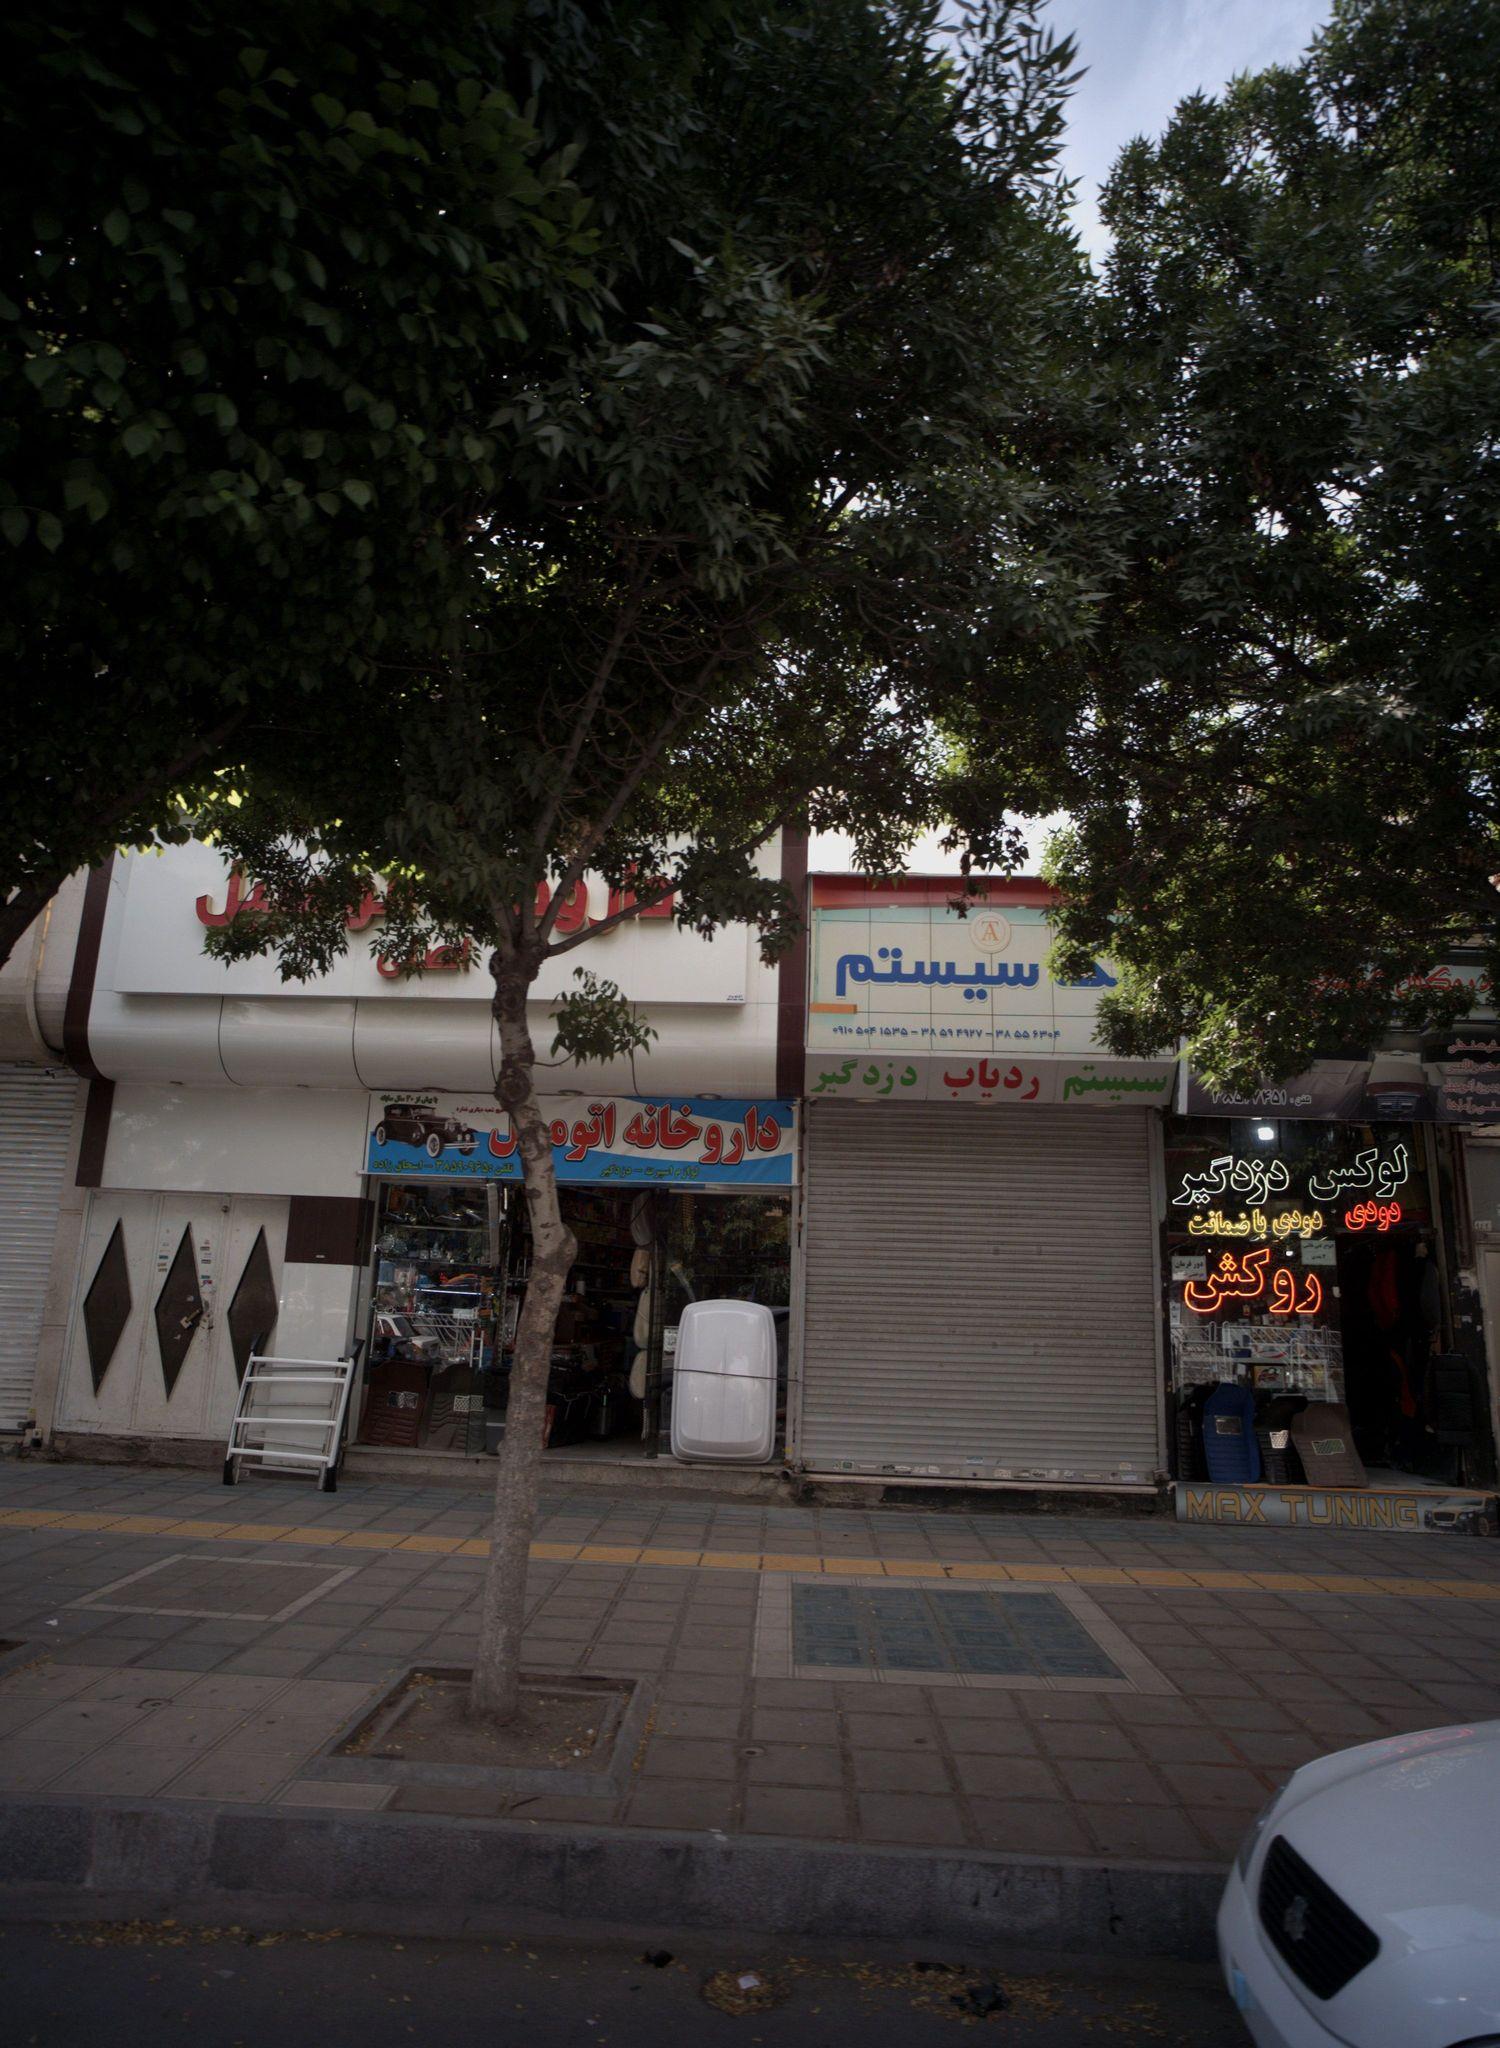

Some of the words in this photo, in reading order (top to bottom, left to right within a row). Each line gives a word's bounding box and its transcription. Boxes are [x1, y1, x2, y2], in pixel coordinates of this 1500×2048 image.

[836, 947, 1039, 998] سیستم
[810, 1059, 917, 1094] دزدگیر
[943, 1058, 1040, 1100] ردیاب
[1063, 1064, 1168, 1100] سیستم
[488, 1101, 615, 1161] اتومل
[624, 1104, 782, 1165] داروخانه
[1172, 1155, 1290, 1205] دزدگیر
[1309, 1144, 1408, 1200] لوکس
[1188, 1210, 1251, 1236] ضمانت
[1253, 1208, 1267, 1239] با
[1272, 1210, 1323, 1238] دودی
[1345, 1201, 1401, 1231] دودی
[1184, 1249, 1322, 1313] روکش
[1186, 1490, 1268, 1523] MAX
[1280, 1494, 1420, 1529] TUNING
